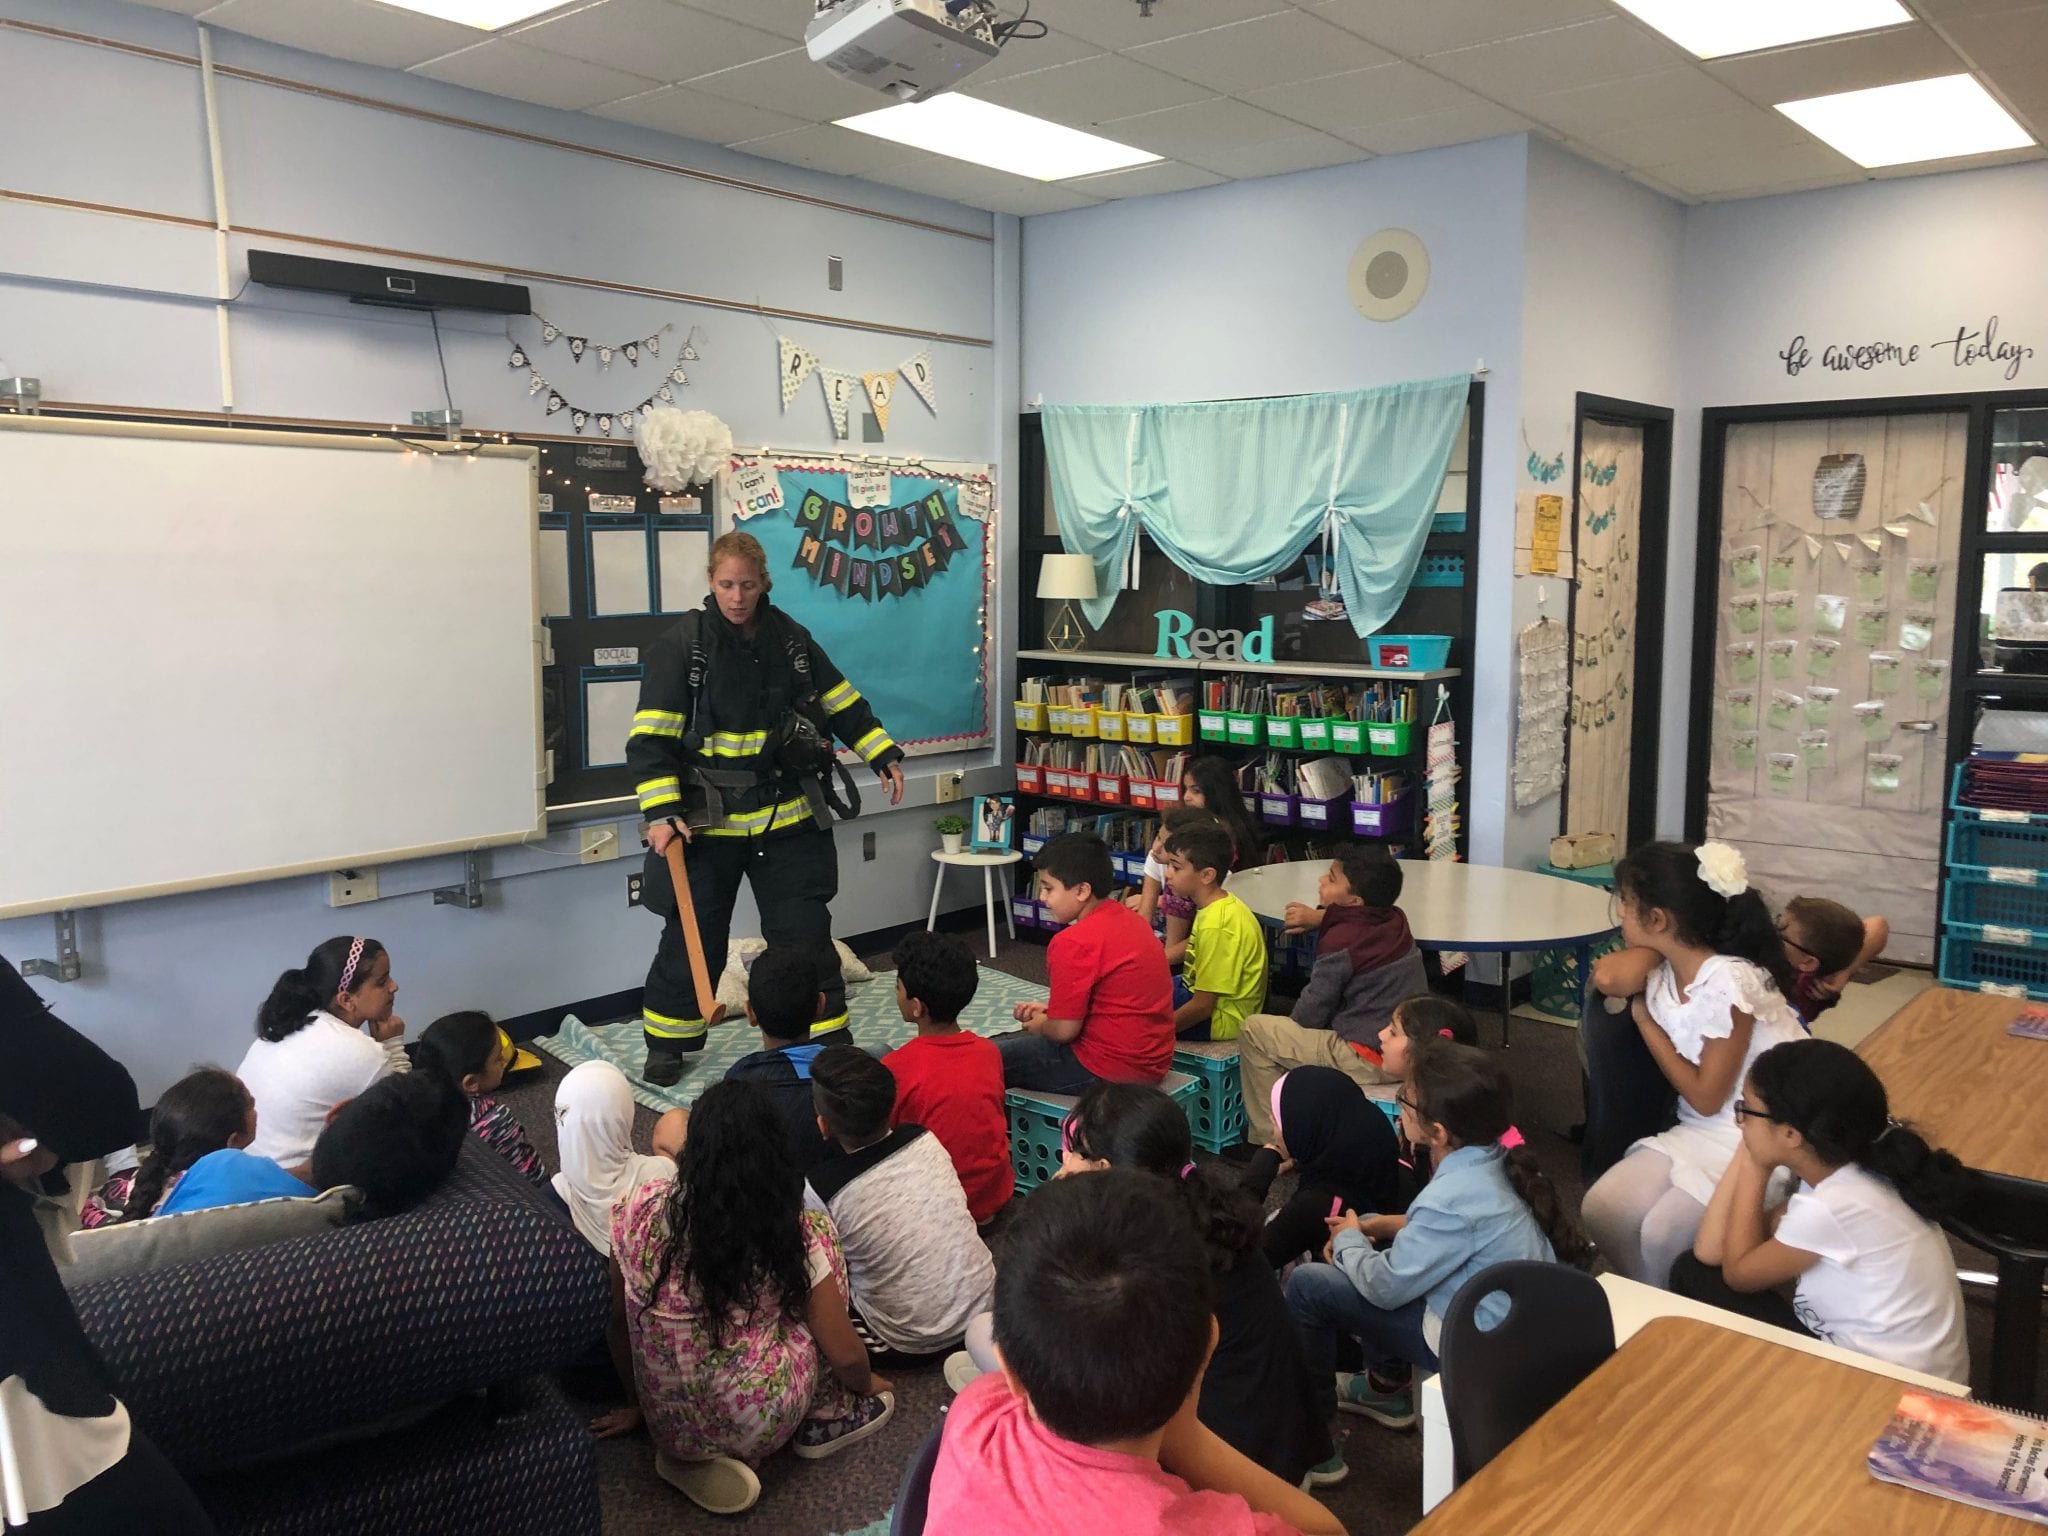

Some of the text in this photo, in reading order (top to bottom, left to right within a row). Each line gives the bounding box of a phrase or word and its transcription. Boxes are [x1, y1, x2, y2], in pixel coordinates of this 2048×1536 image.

[1779, 315, 2034, 381] be awesome today
[790, 353, 926, 402] READ
[803, 494, 946, 537] GROWTH
[597, 649, 633, 660] SOCIAL
[1152, 608, 1275, 664] Read
